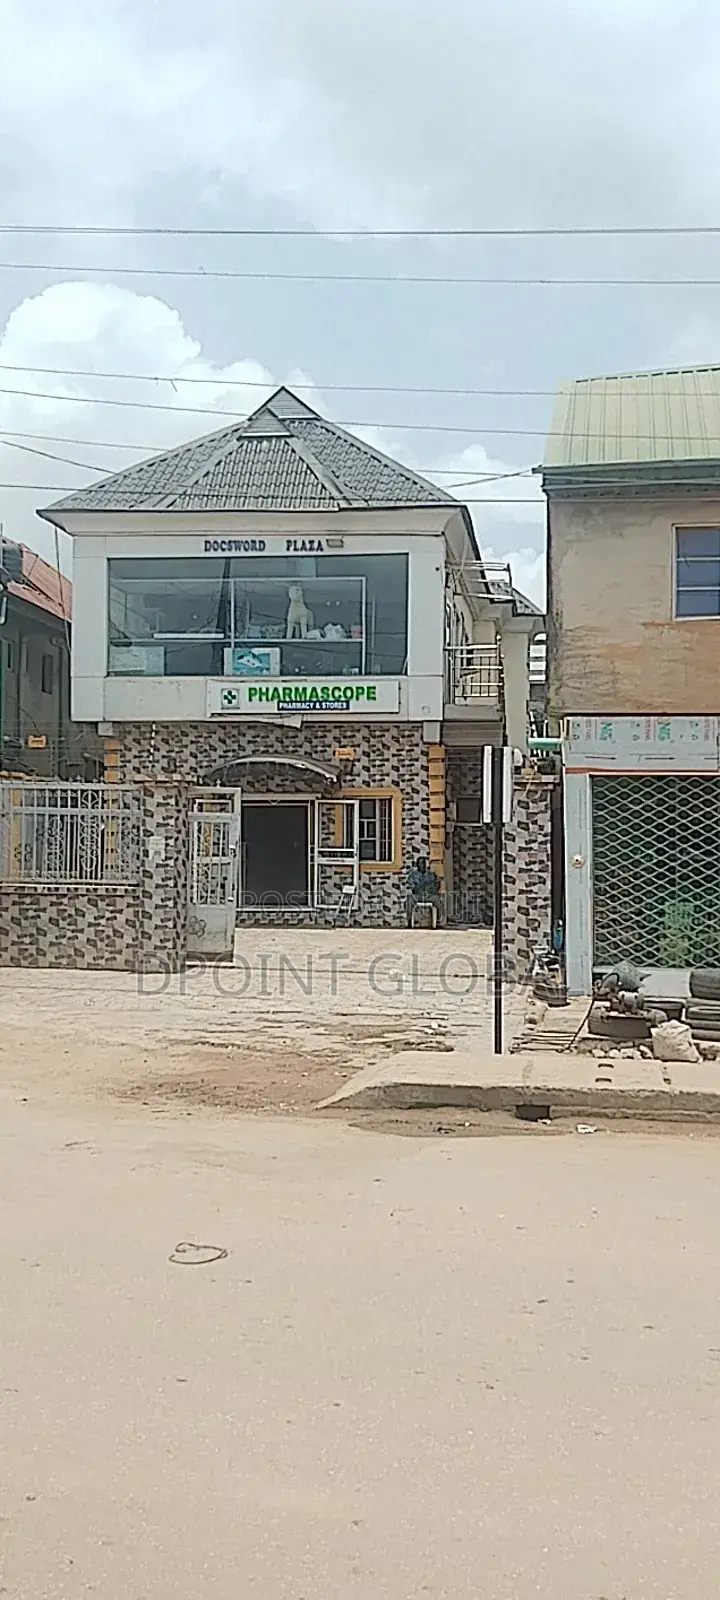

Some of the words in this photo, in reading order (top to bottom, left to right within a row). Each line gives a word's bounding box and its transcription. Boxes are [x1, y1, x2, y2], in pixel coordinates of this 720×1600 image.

[204, 539, 266, 552] DOCSWORD
[286, 539, 324, 552] PLAZA
[248, 686, 377, 702] PHARMASCOPE
[279, 702, 314, 710] PHARMACY
[322, 701, 347, 709] STORES
